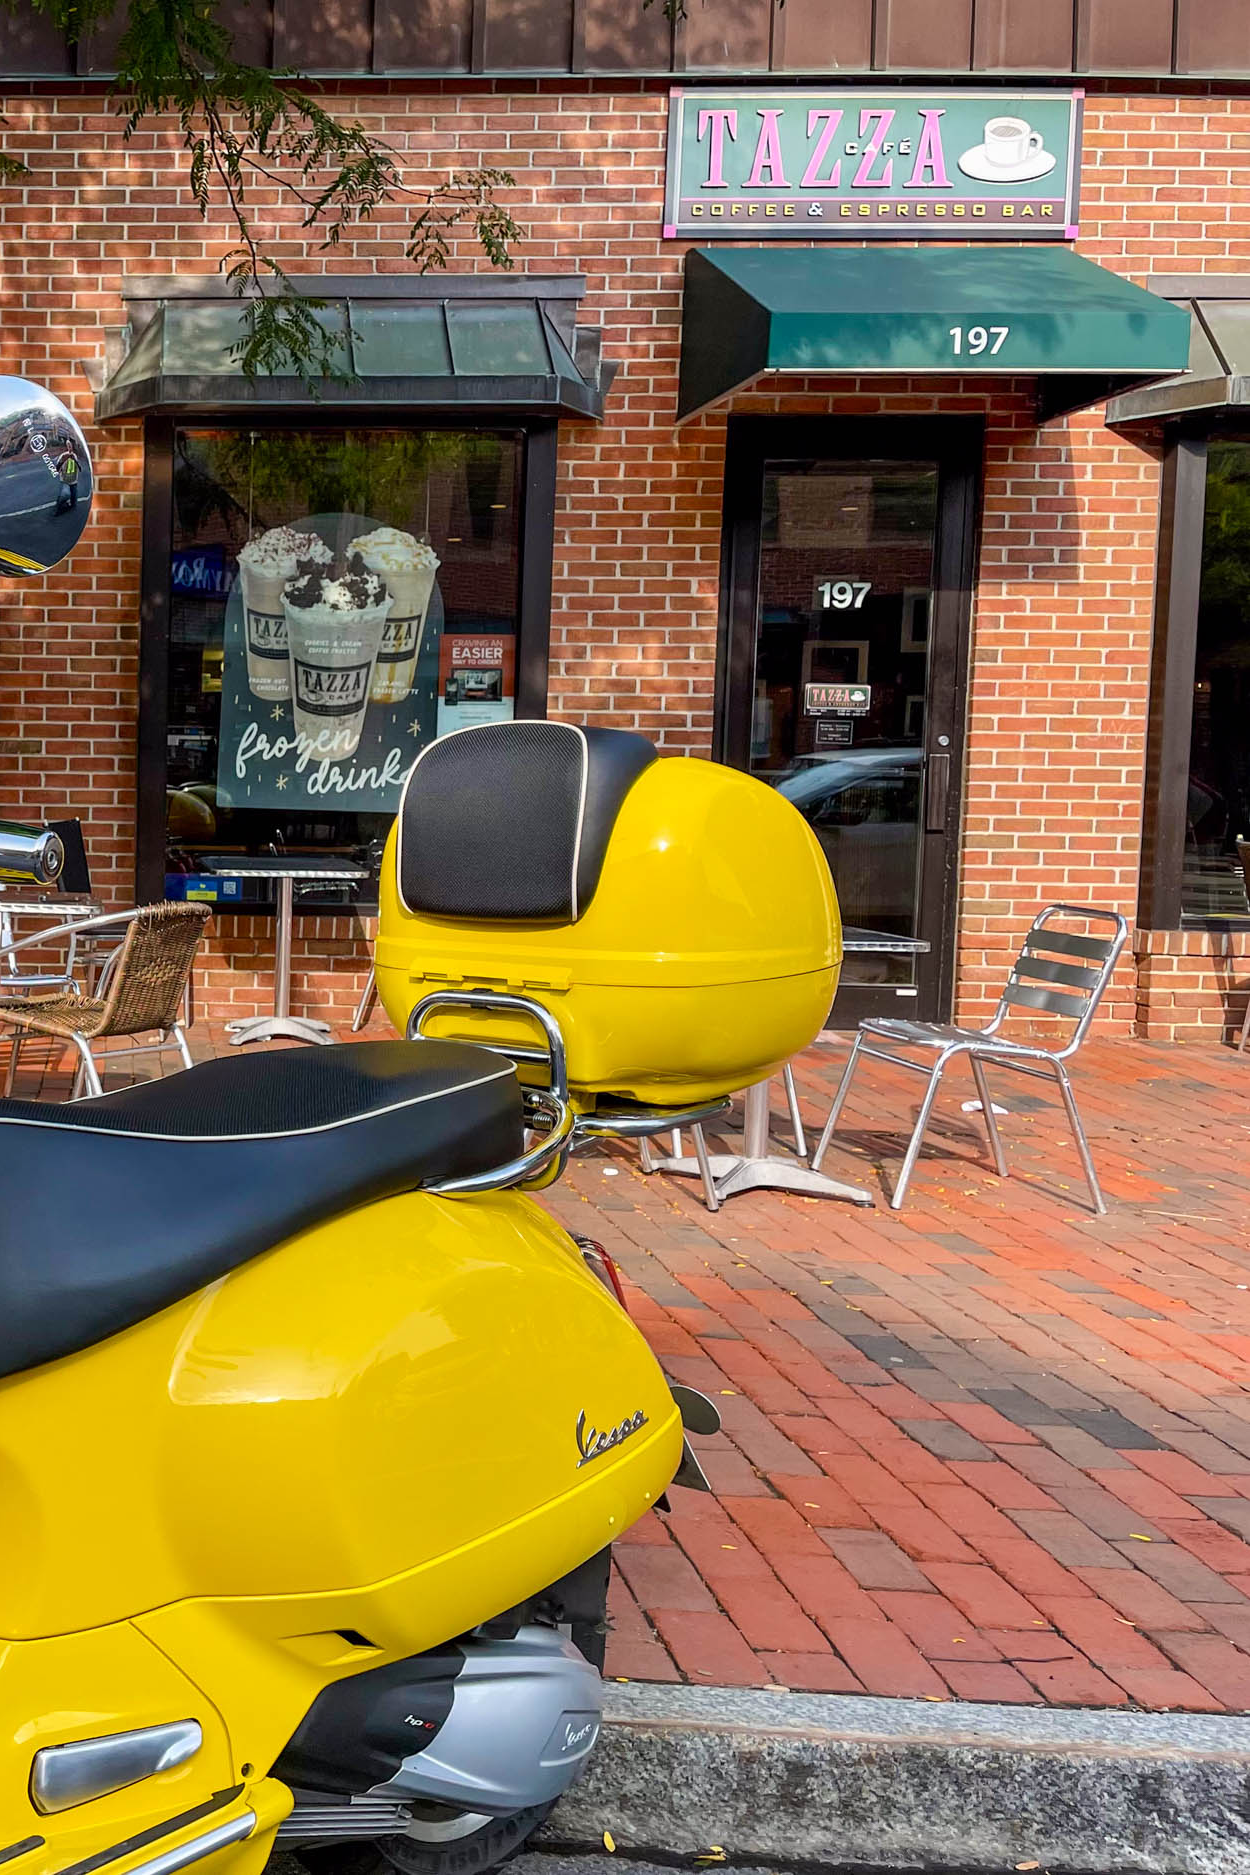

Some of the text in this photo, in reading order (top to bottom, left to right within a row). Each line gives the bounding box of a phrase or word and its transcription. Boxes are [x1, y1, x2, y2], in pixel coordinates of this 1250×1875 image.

[697, 109, 955, 188] TAZZA
[691, 202, 1054, 217] COFFEE & ESPRESSO BAR
[949, 326, 1009, 355] 197
[818, 581, 872, 609] 197
[253, 616, 290, 638] TAZ
[382, 623, 413, 641] ZZA
[452, 639, 503, 647] CRAVING AN
[452, 647, 503, 659] EASIER
[303, 669, 361, 693] TAZZA
[813, 688, 850, 702] TAZZA
[235, 722, 361, 779] frozen
[576, 1408, 649, 1469] Vespa
